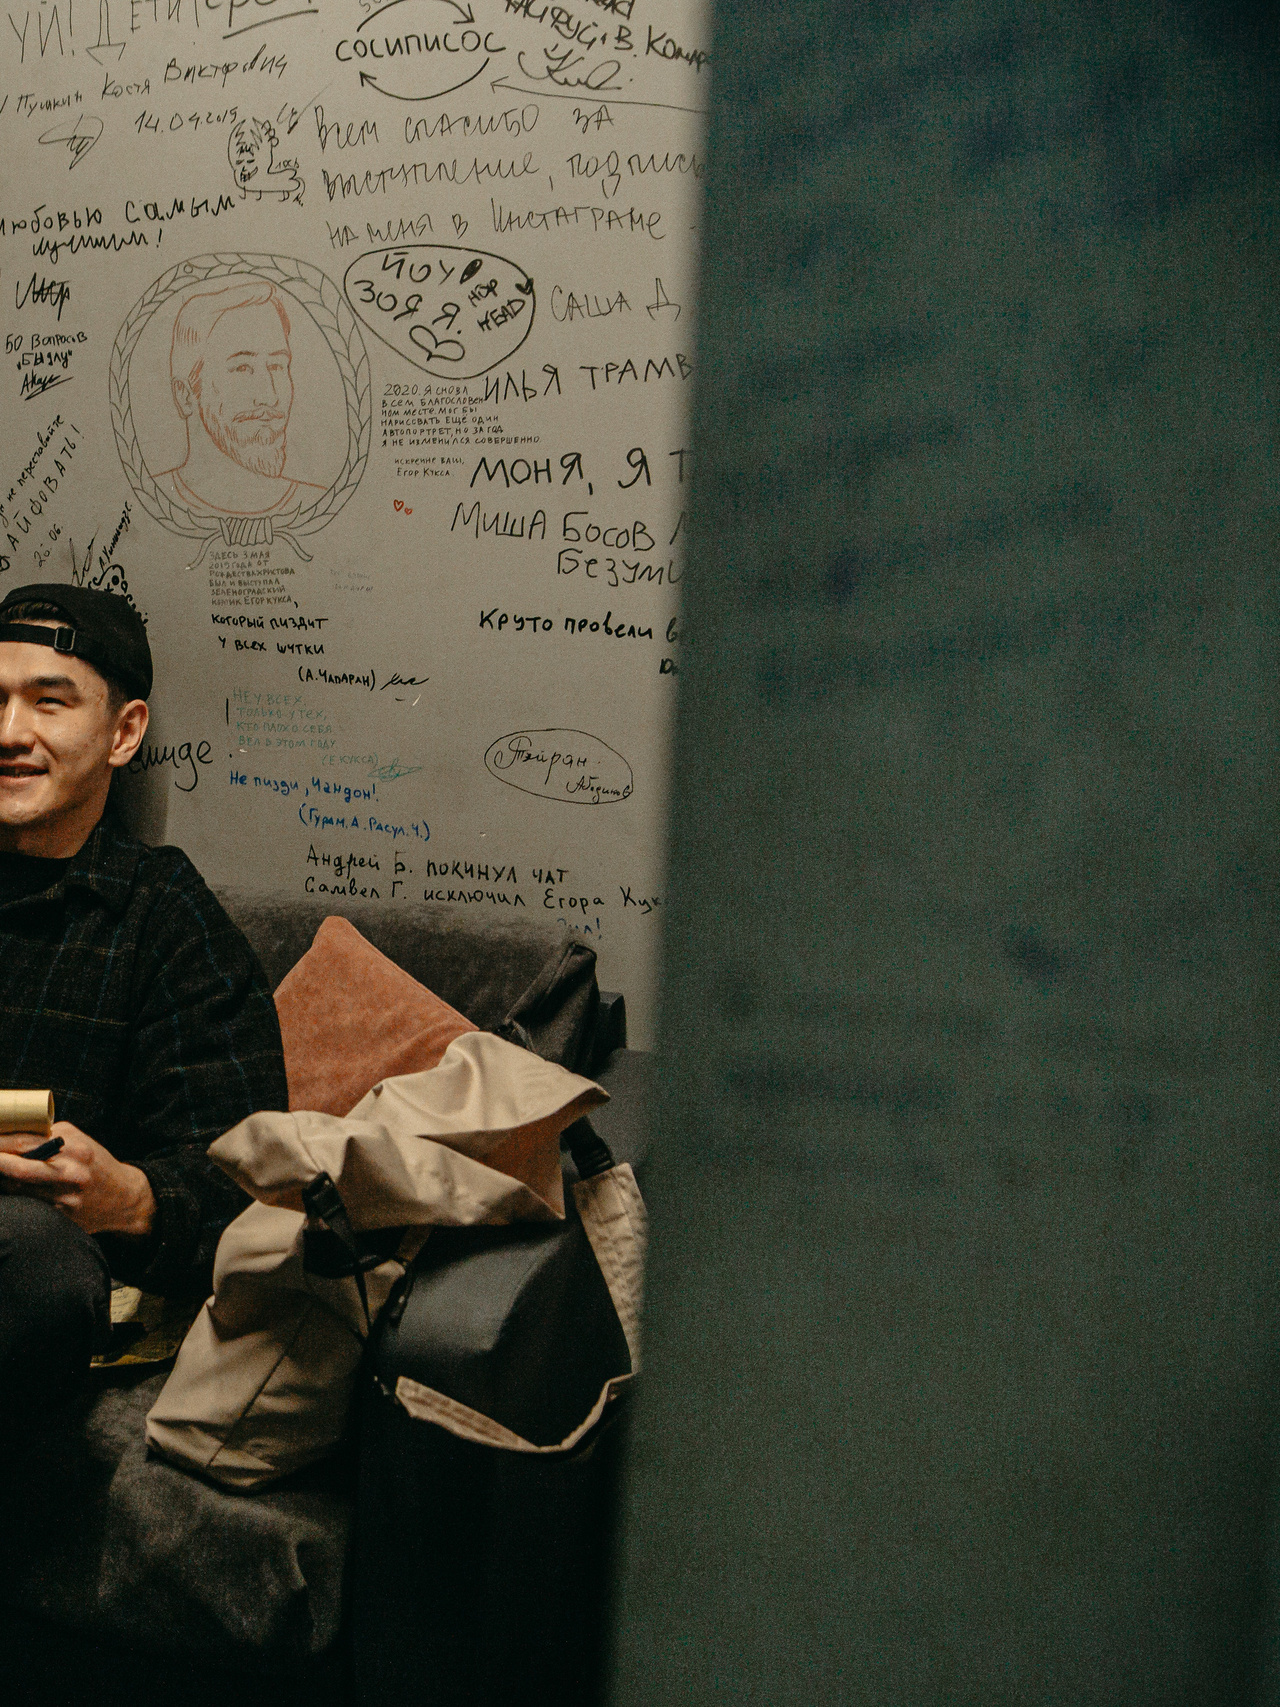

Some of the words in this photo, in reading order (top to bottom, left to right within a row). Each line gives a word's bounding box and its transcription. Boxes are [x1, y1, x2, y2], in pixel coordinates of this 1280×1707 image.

[335, 30, 507, 62] СОСИПИСОС
[550, 285, 633, 323] САША
[484, 363, 562, 404] ИЛЬЯ
[230, 770, 248, 785] Не
